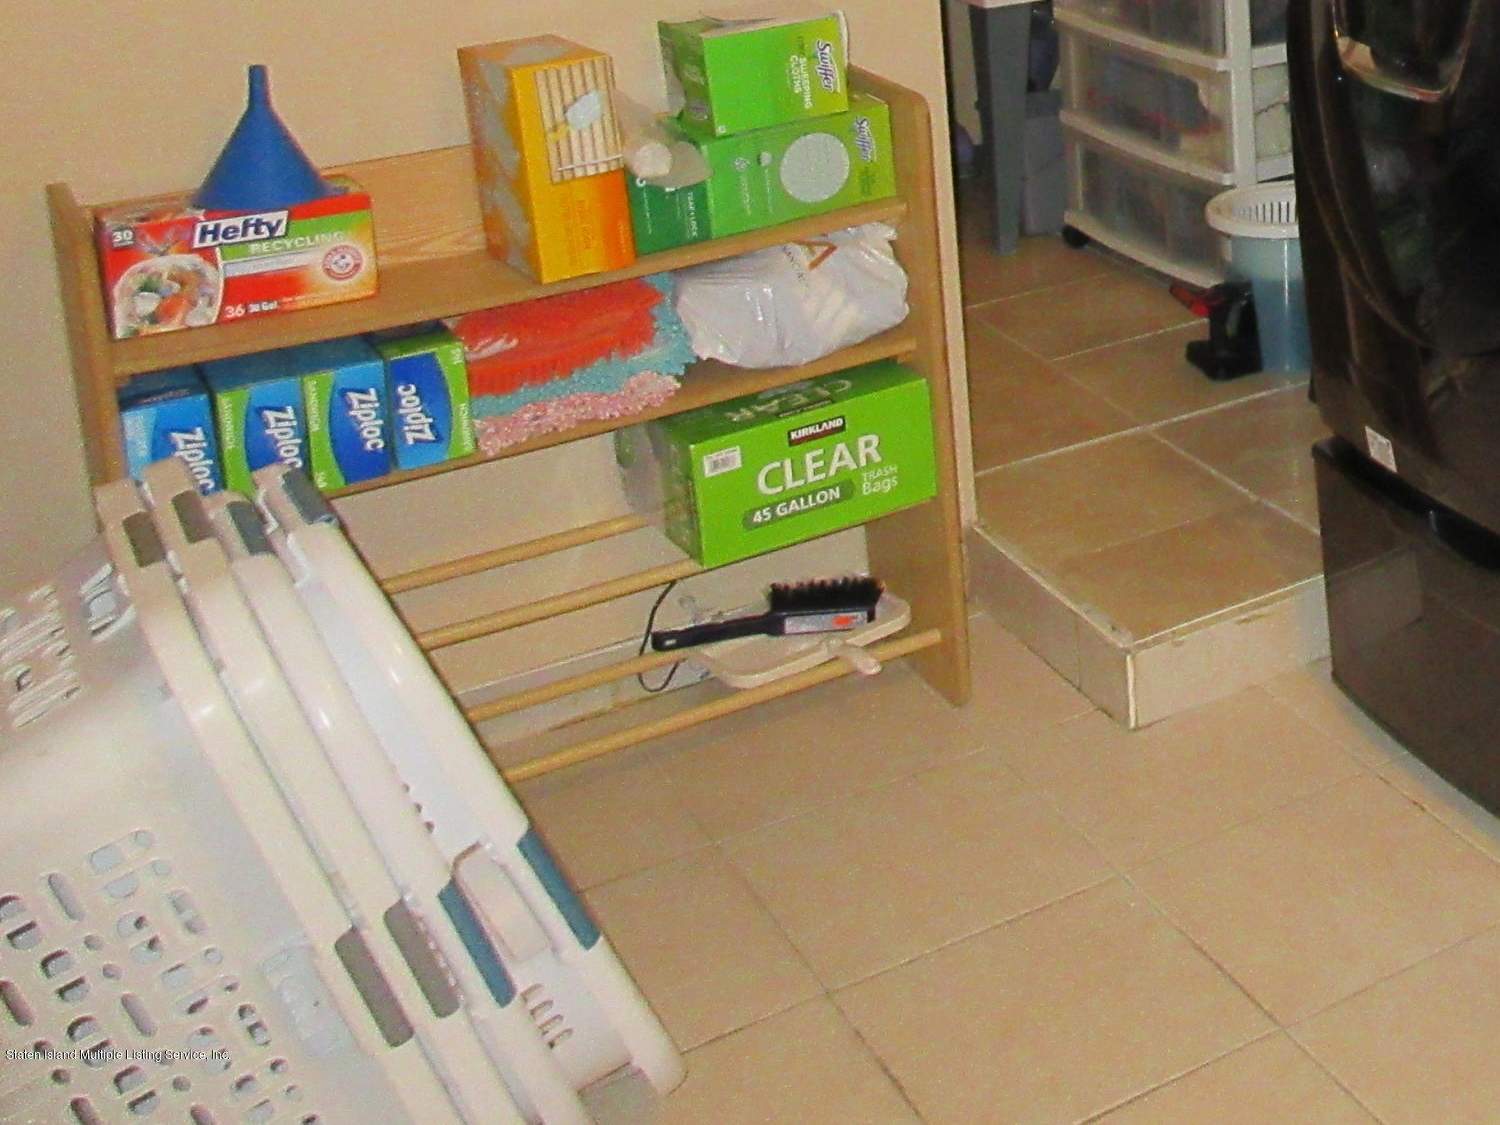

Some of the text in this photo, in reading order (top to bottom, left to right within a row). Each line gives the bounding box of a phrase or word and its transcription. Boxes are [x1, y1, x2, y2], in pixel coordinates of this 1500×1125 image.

[815, 39, 836, 93] Swiffer
[855, 116, 873, 163] Swiffer
[199, 216, 284, 244] Hefty
[249, 230, 345, 255] RECYCLING
[262, 405, 303, 468] Ziploc
[346, 387, 385, 452] Ziploc
[397, 383, 437, 446] Ziploc
[790, 417, 844, 440] KIRKLAND
[170, 426, 216, 490] Ziploc
[757, 433, 883, 496] CLEAR
[861, 464, 898, 482] TRASH
[751, 486, 841, 525] 45 GALLON
[861, 476, 899, 497] Bags
